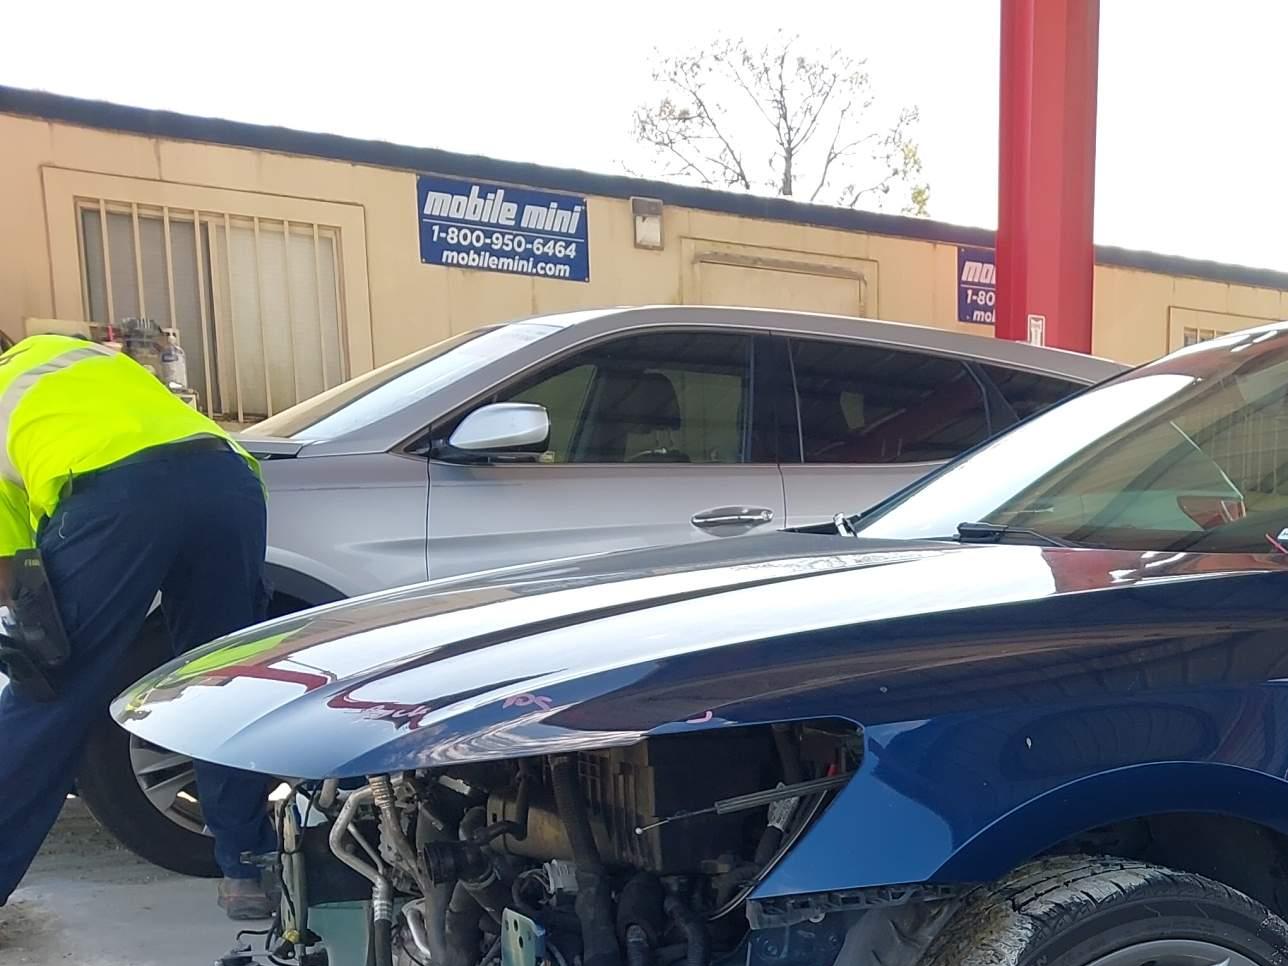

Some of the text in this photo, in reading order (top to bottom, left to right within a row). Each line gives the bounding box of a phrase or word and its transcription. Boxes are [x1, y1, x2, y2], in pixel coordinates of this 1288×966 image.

[423, 185, 582, 234] mobile mini
[431, 224, 577, 259] 1-800-950-6464
[441, 249, 570, 278] mobilemini.com
[966, 288, 996, 306] 1-80
